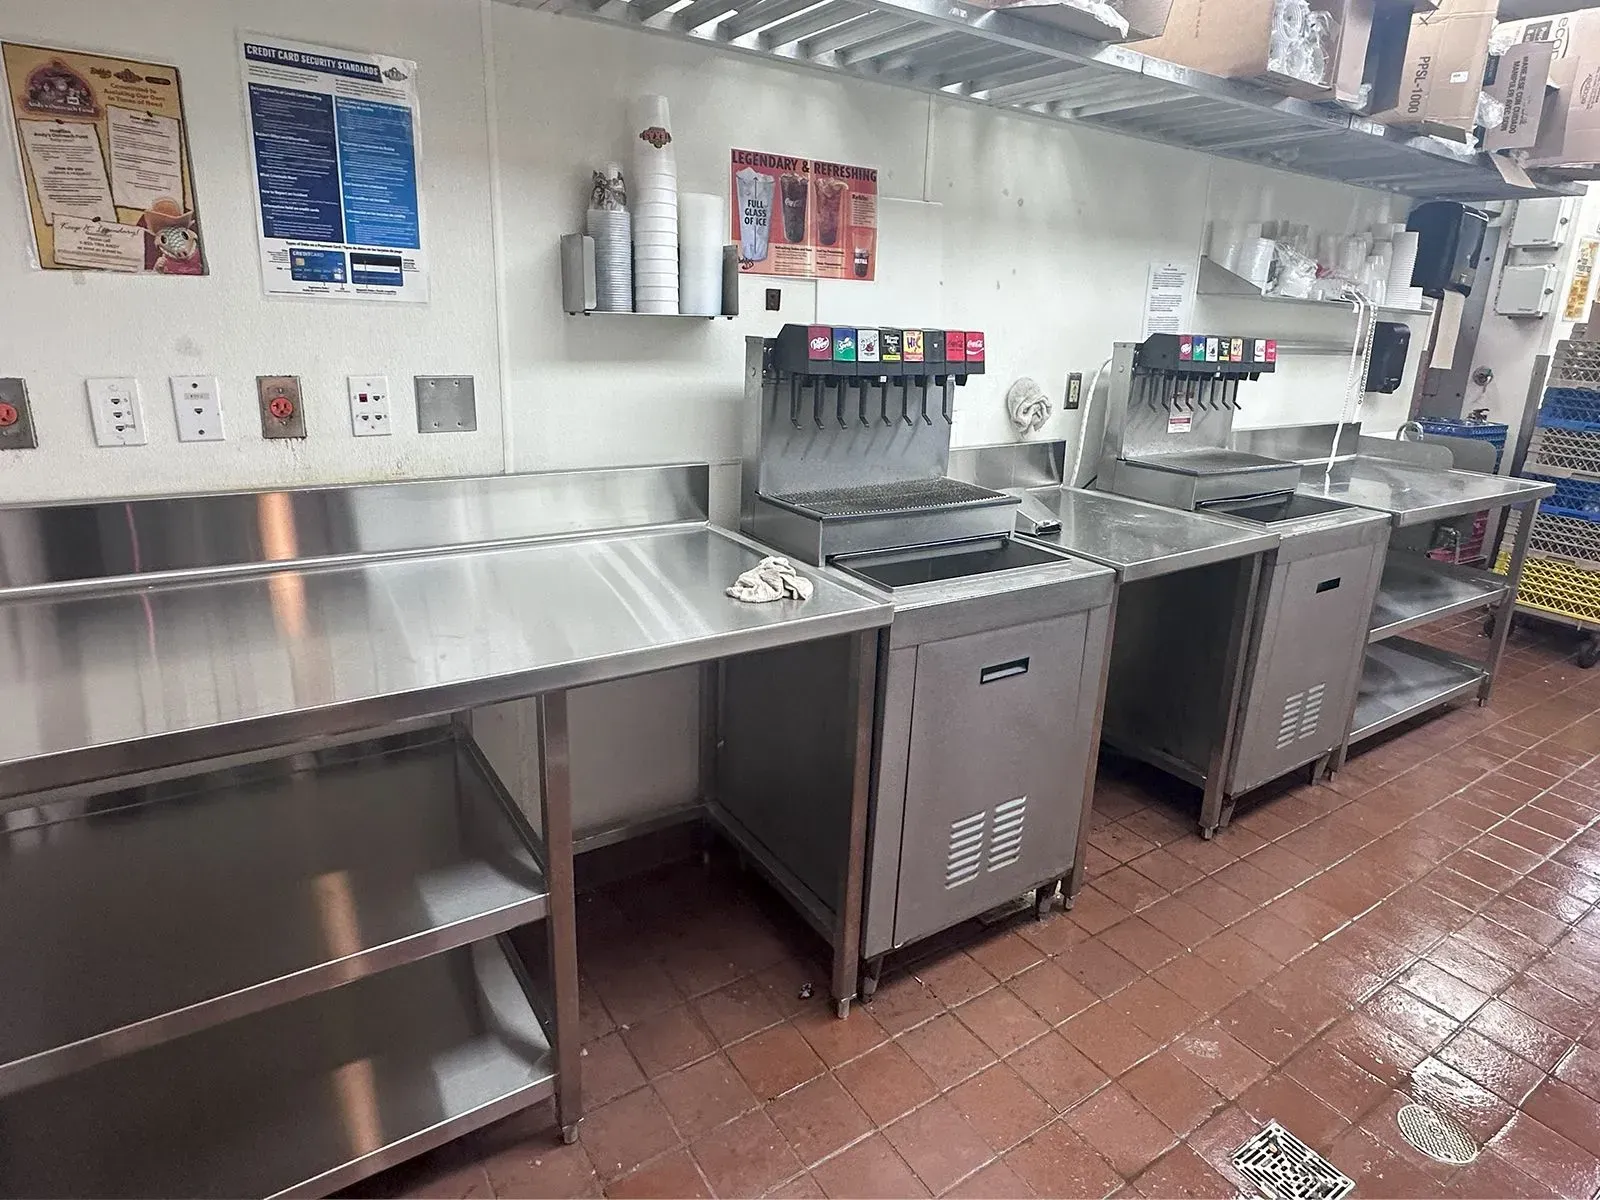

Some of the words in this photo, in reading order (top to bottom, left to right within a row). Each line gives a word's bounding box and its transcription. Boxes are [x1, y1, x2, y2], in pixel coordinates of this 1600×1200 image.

[246, 45, 276, 60] CREDIT
[278, 50, 300, 63] CARD
[300, 54, 337, 69] SECURITY
[338, 61, 379, 76] STANDARDS
[1407, 56, 1431, 114] PPSL-1000
[1508, 105, 1520, 134] CUIDADO
[732, 149, 800, 172] LEGENDARY
[801, 160, 810, 173] &
[814, 161, 878, 183] REFRESHING
[744, 207, 767, 218] GLASS
[747, 199, 764, 209] FULL
[744, 216, 754, 225] OF
[755, 217, 767, 227] ICE
